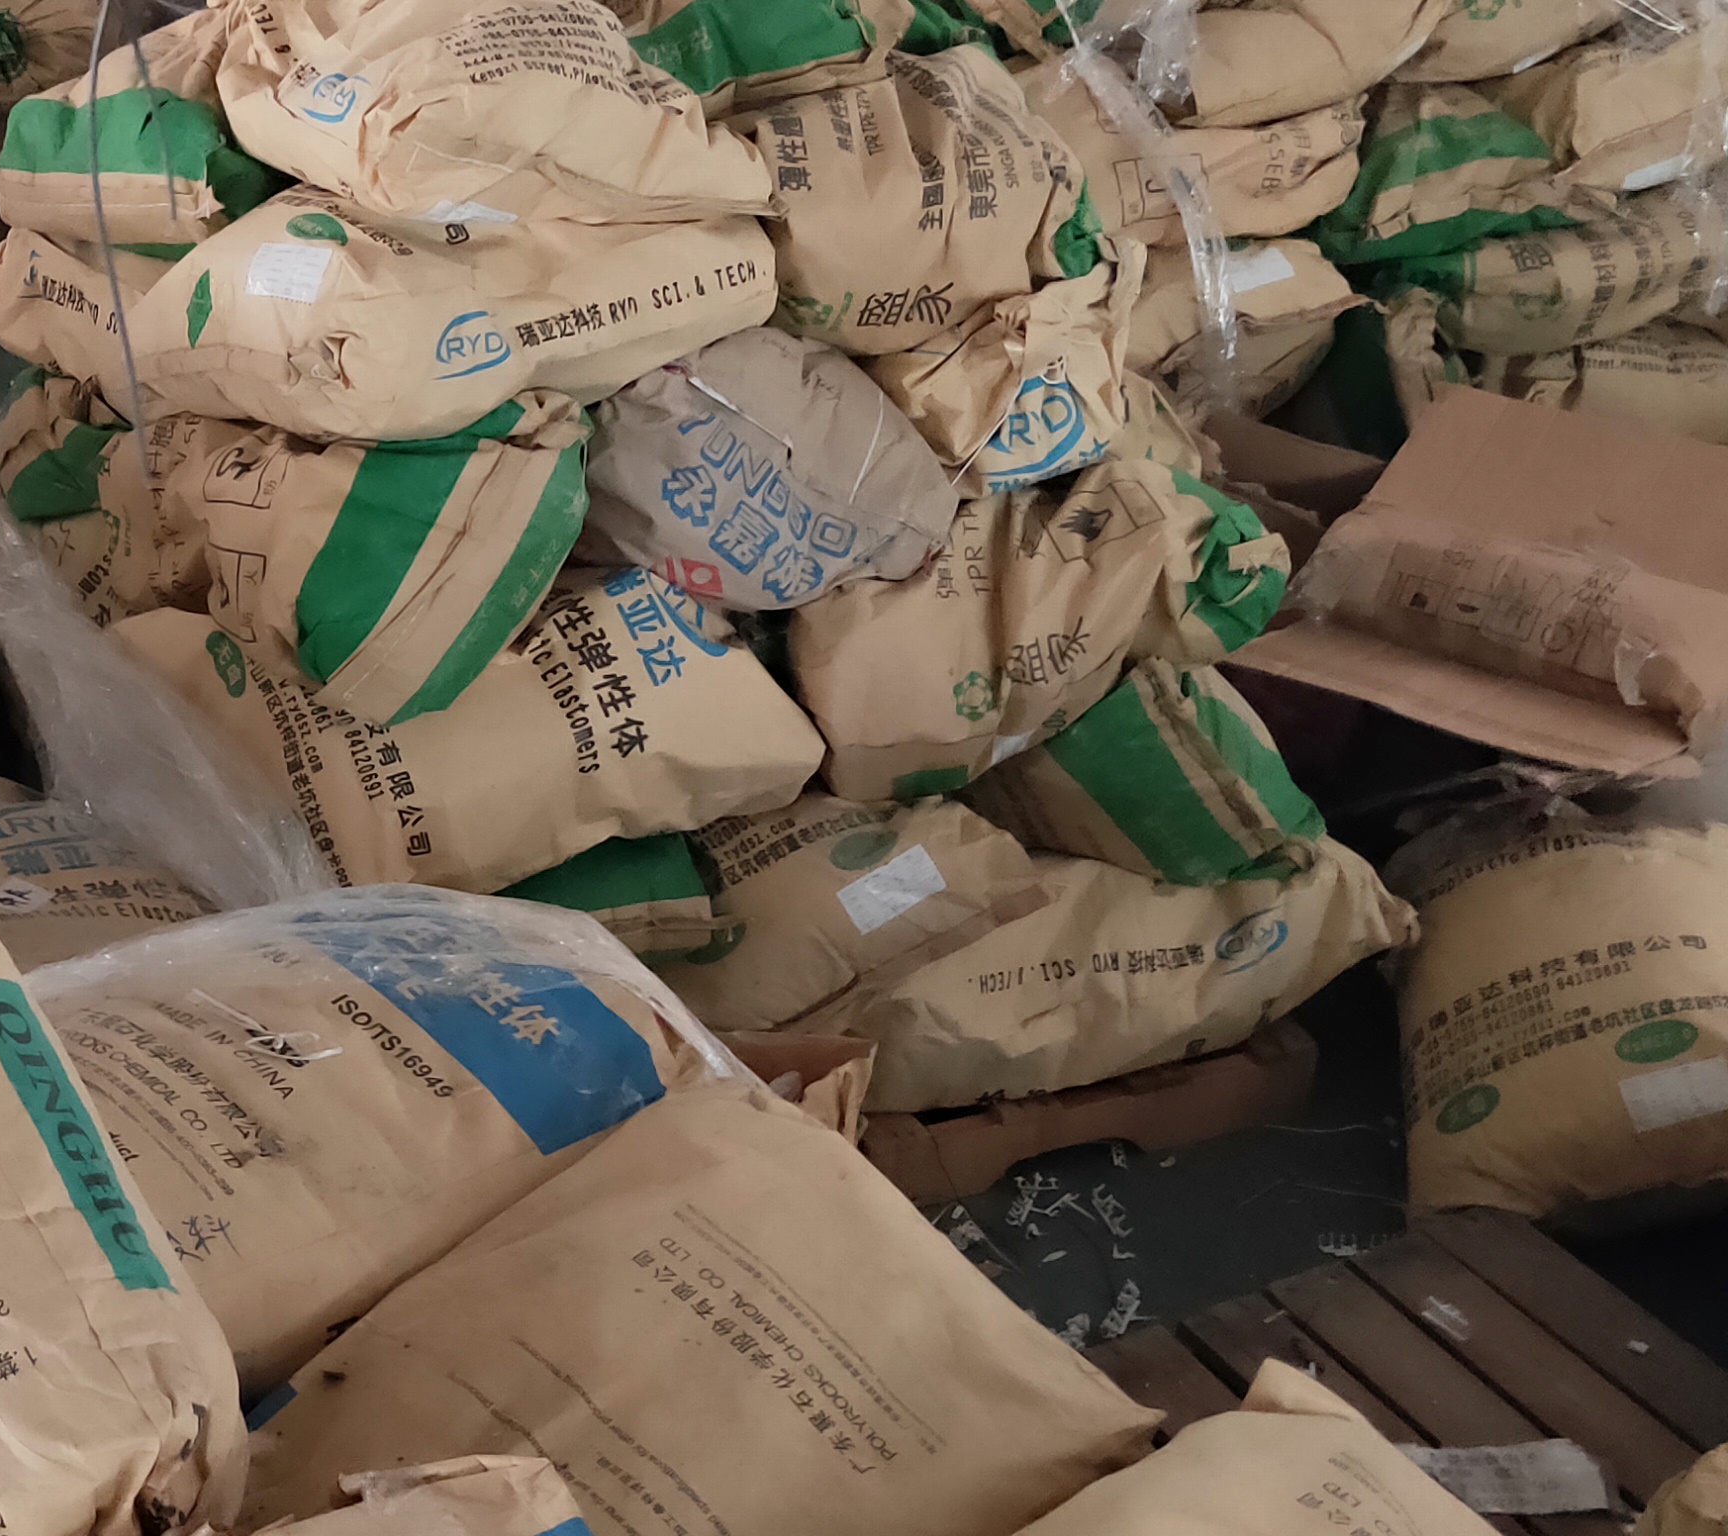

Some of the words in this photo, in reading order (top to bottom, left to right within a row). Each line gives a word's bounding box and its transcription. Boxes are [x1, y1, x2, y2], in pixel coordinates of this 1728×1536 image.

[444, 332, 508, 361] RYD
[514, 301, 606, 350] 瑞亚达科技
[648, 278, 692, 310] SCI.
[538, 659, 602, 776] Elastomers
[343, 726, 385, 801] 84120691
[1090, 950, 1120, 974] RYD
[154, 997, 207, 1035] MADE
[206, 1025, 234, 1051] IN
[232, 1043, 294, 1100] CHINA
[328, 988, 456, 1103] ISO/TS16949
[107, 1045, 182, 1108] CHEMICAL
[208, 1136, 245, 1173] LTD
[656, 1231, 693, 1266] LTD
[628, 1243, 878, 1481] 广东聚石化学股份有限公司
[724, 1287, 808, 1366] CHEMICAL
[800, 1360, 900, 1464] POLYROCKS
